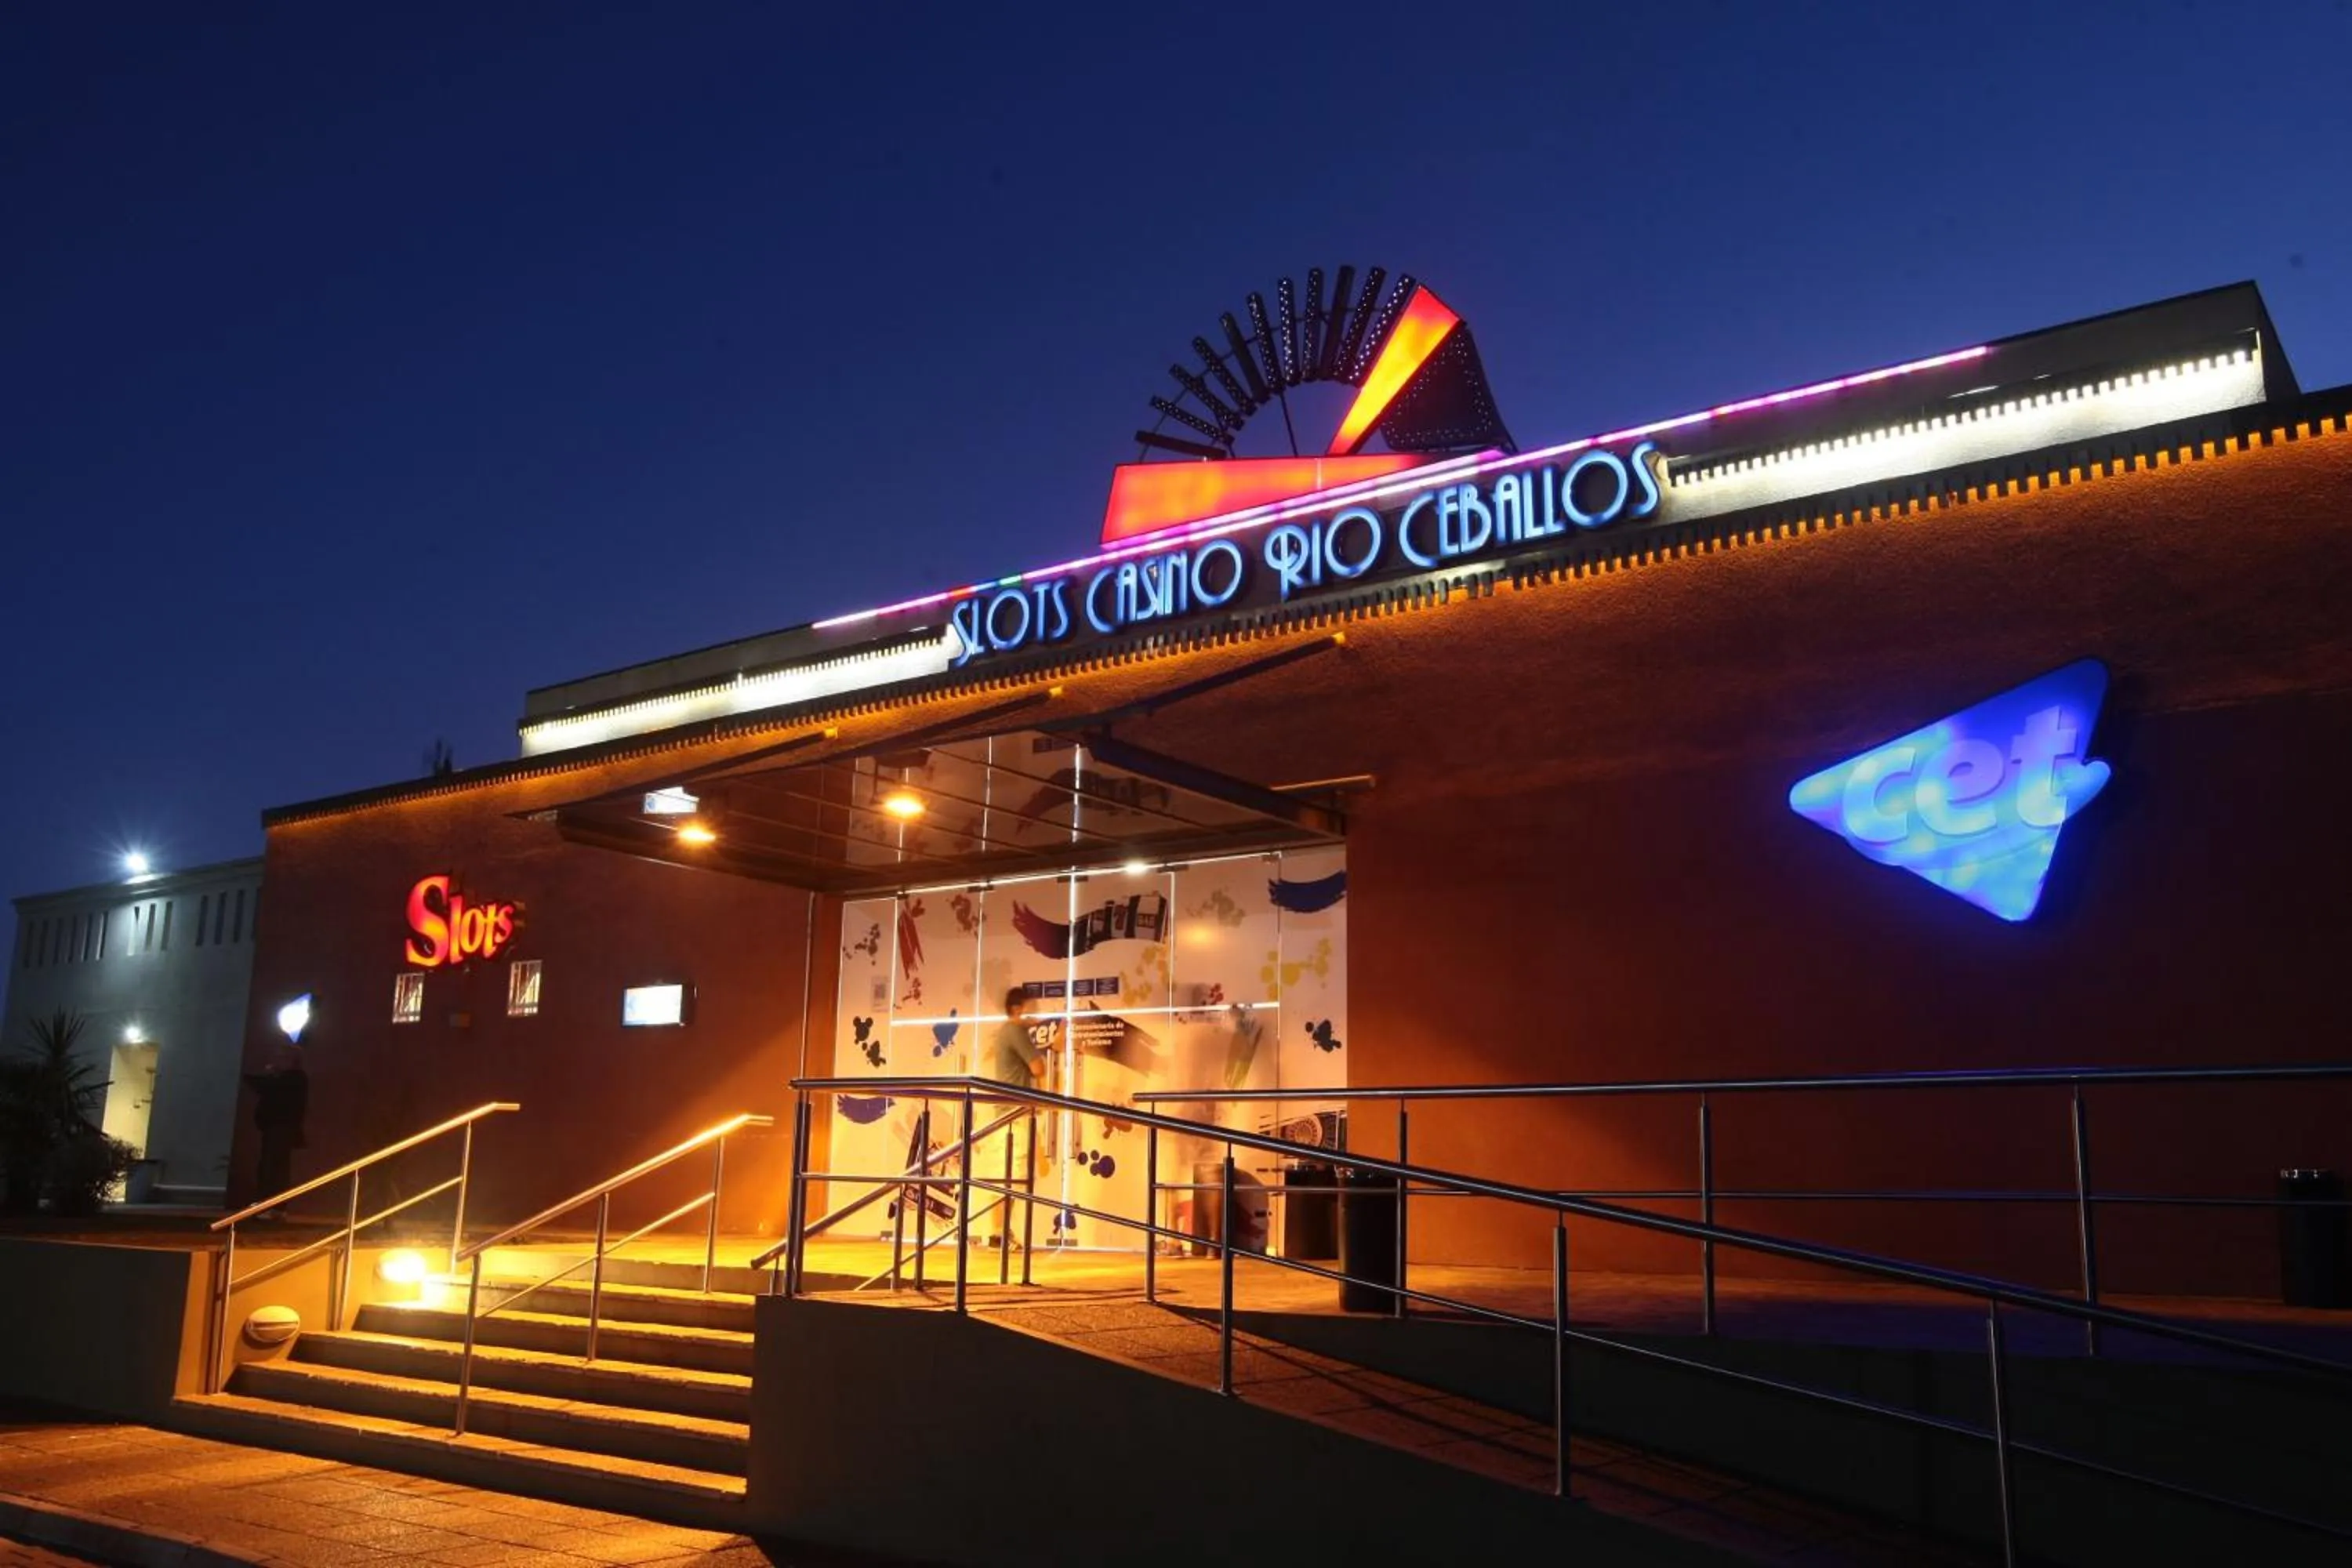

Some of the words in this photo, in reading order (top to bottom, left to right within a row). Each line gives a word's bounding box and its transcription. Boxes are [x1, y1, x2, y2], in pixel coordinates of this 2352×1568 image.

[953, 579, 1069, 667] SLOTS
[1086, 539, 1243, 633] CASINO
[1264, 507, 1381, 602] RIO
[1399, 440, 1659, 568] CEBALLOS
[1842, 704, 2078, 844] cet
[405, 874, 514, 967] Slots
